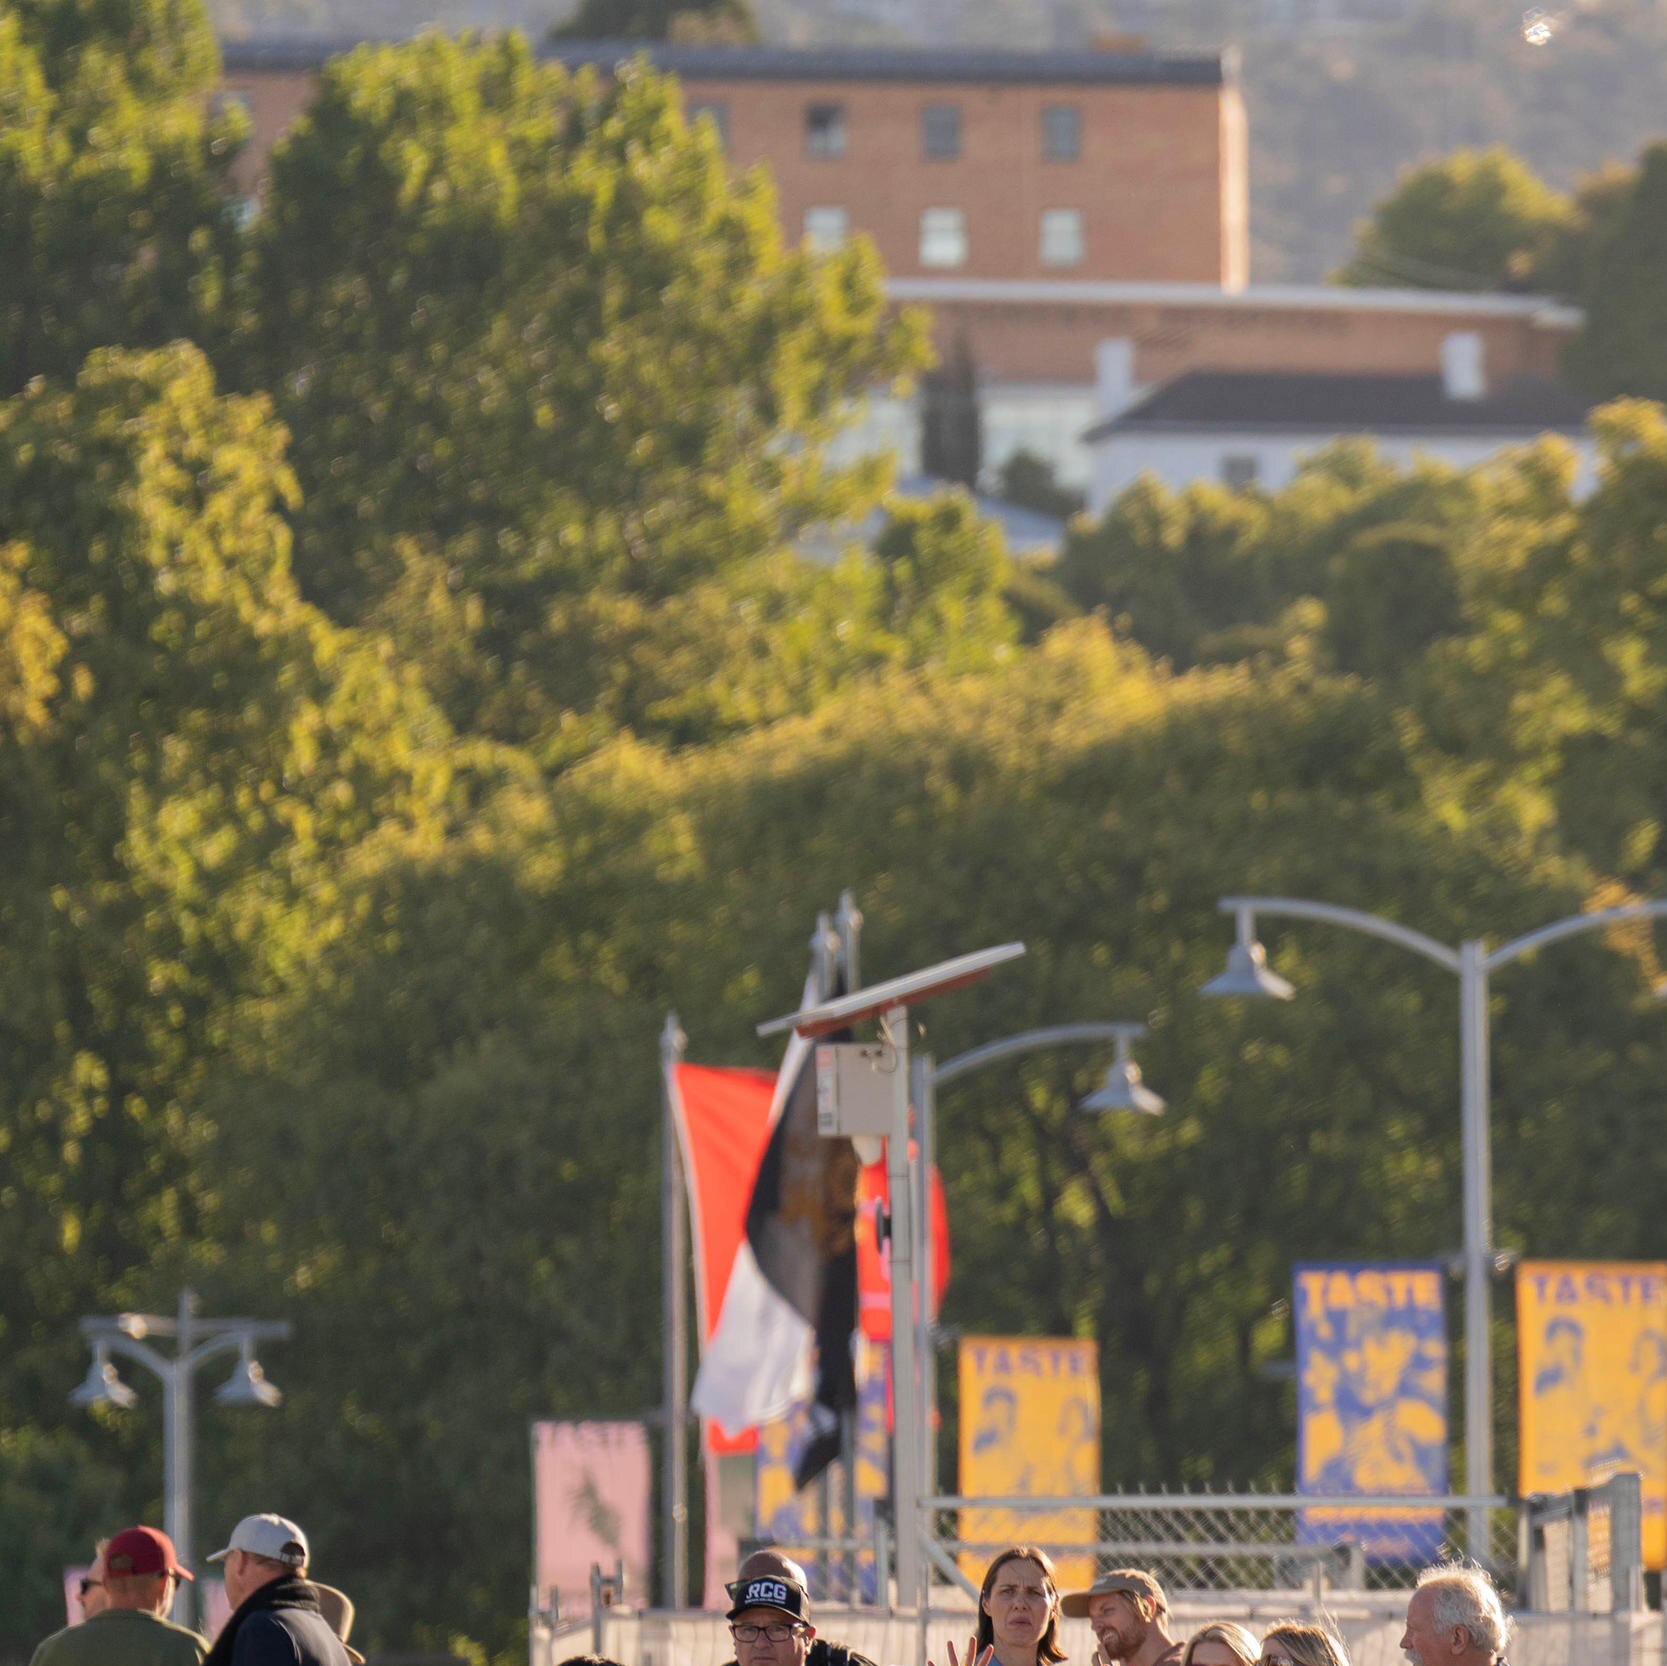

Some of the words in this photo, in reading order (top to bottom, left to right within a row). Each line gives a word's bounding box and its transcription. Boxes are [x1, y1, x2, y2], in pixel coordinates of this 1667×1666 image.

[1302, 1269, 1441, 1311] TASTE
[1533, 1273, 1663, 1303] TASTE
[972, 1345, 1089, 1376] TASTE
